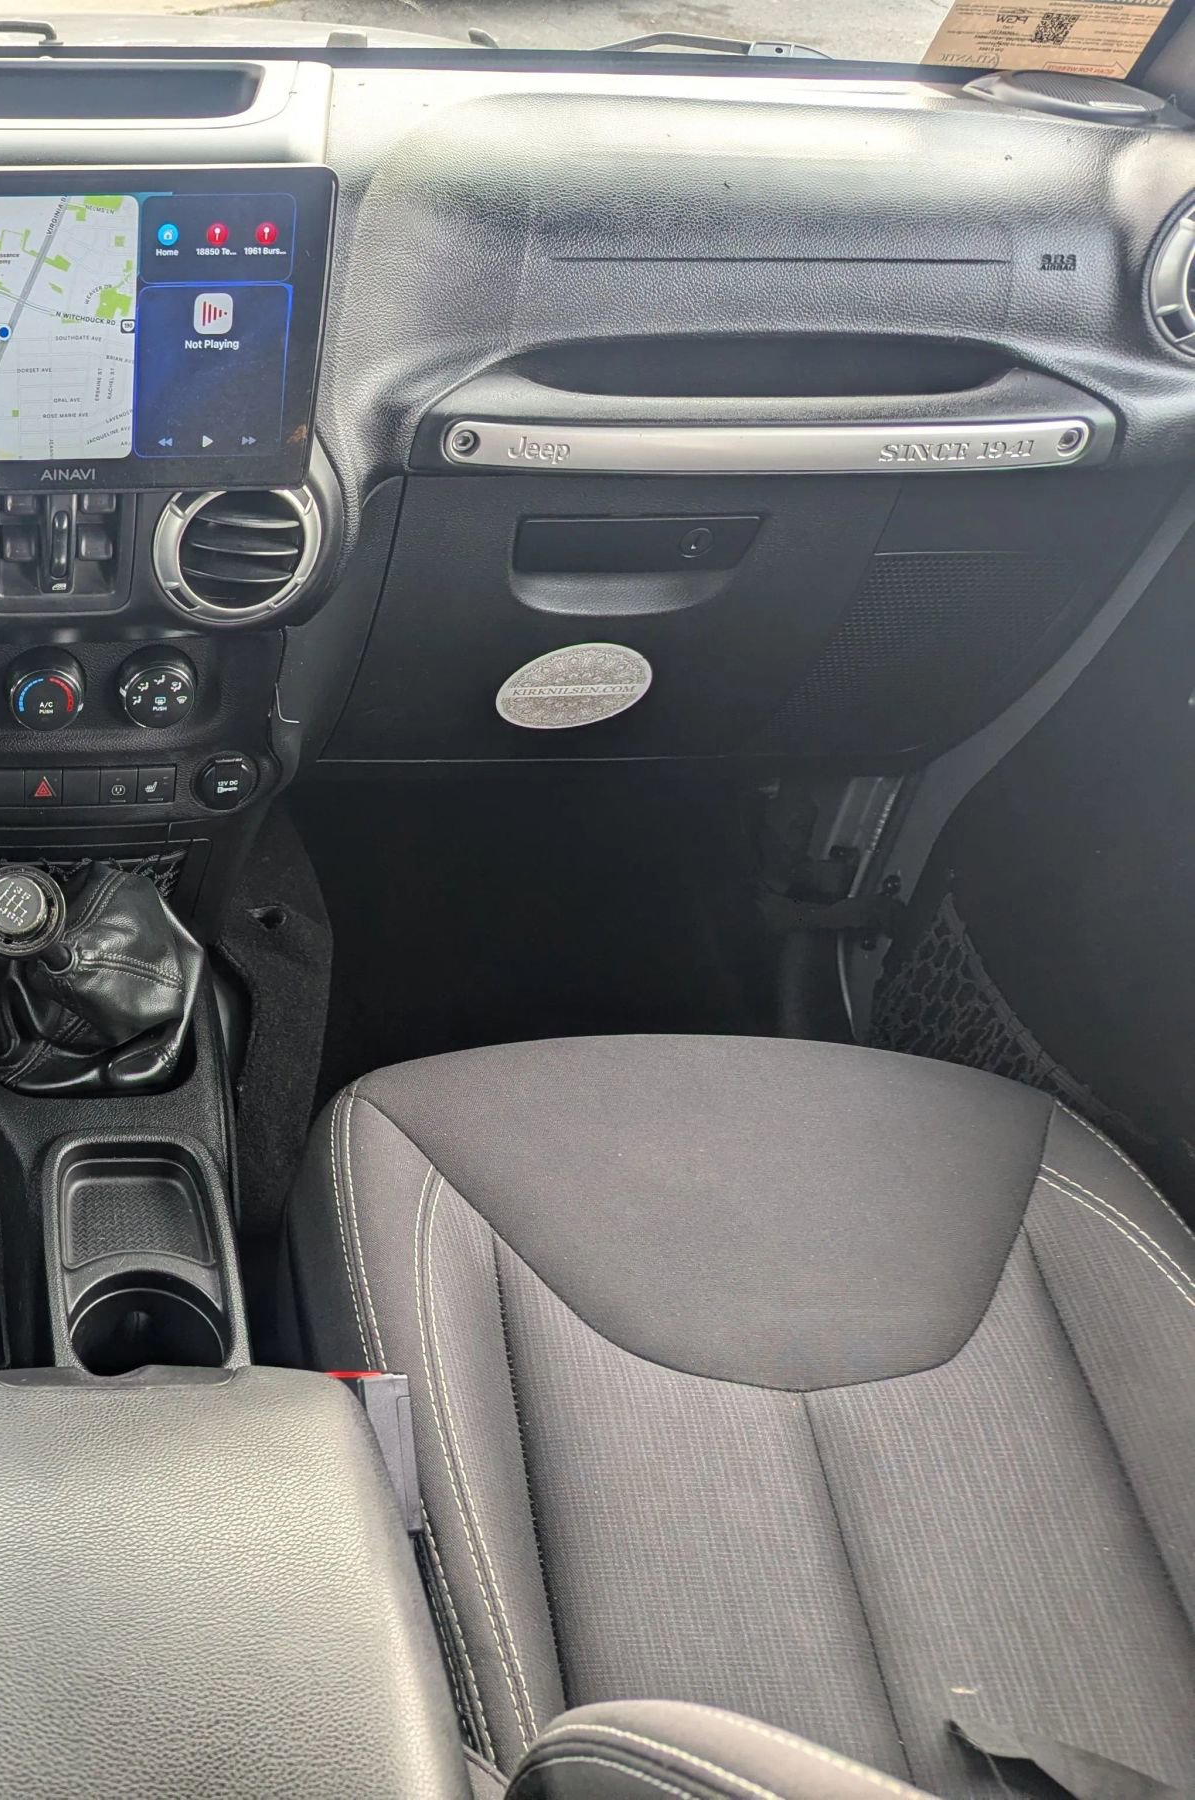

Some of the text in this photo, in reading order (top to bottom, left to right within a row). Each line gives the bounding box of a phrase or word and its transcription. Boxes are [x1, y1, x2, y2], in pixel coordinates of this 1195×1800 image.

[46, 203, 64, 236] VIRGINIA
[156, 248, 179, 256] Home
[1042, 253, 1076, 264] SRS
[62, 312, 105, 324] WITCHDUCK
[184, 338, 240, 350] Not Playing
[507, 436, 571, 465] Jeep
[878, 440, 1035, 462] SINCE 1941
[40, 468, 96, 481] AINAVI
[512, 684, 636, 698] KIRKNILSEN.COM
[39, 701, 54, 709] A/C
